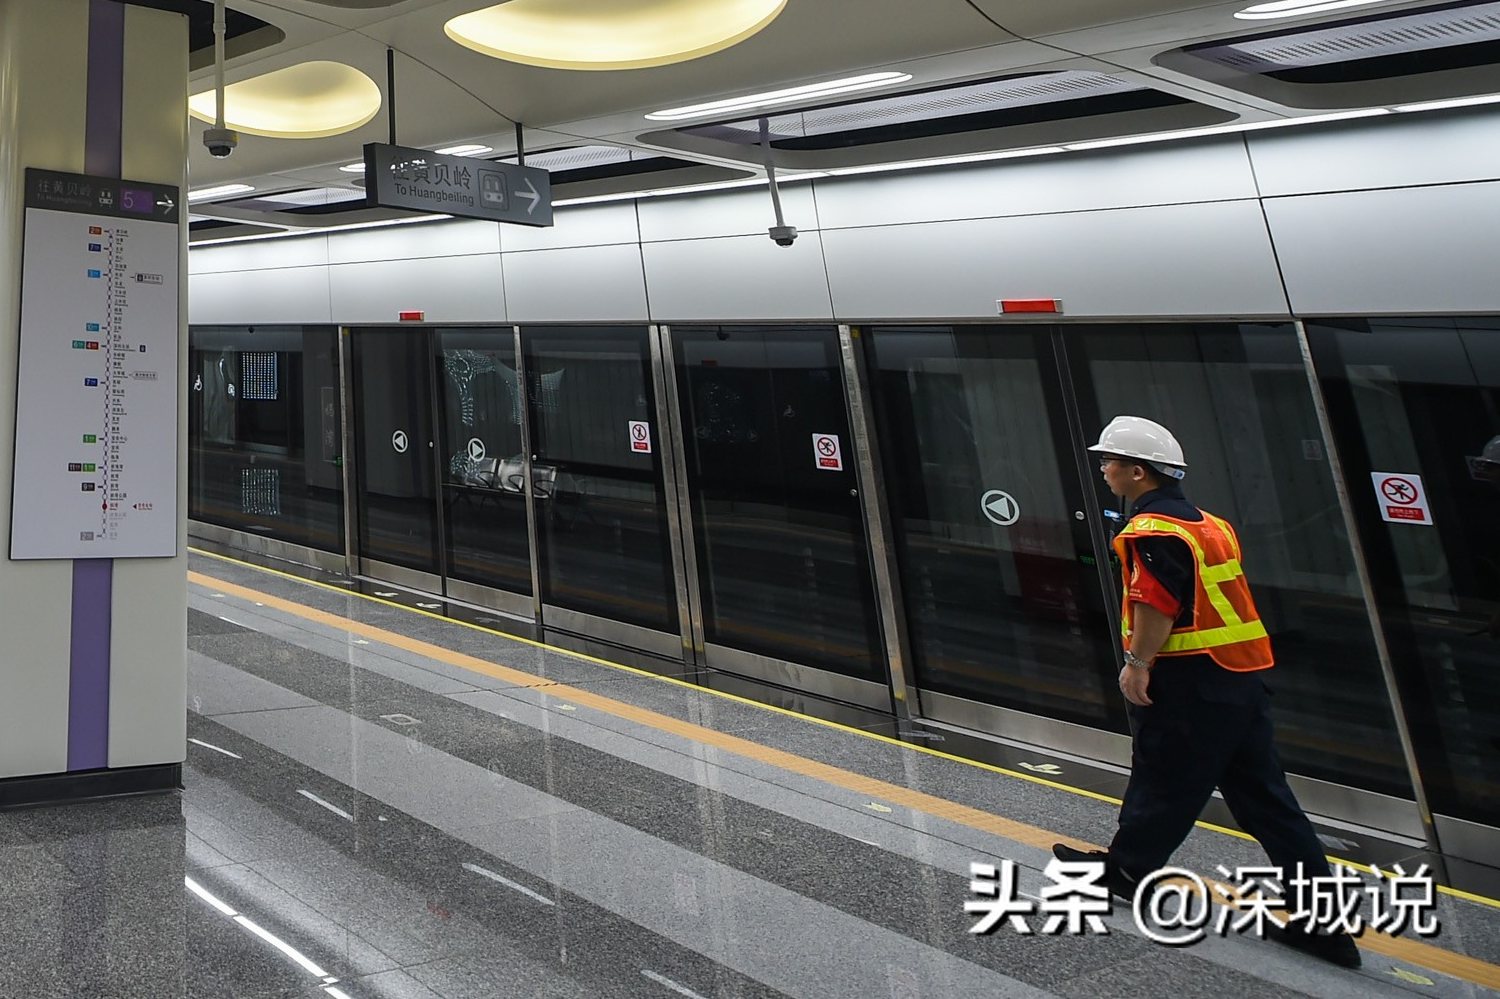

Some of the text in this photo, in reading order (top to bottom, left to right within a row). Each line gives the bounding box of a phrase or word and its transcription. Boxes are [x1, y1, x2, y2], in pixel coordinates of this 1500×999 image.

[389, 155, 472, 190] 往黄贝岭
[38, 179, 92, 197] 往黄贝岭
[394, 183, 474, 207] To Huangbeiling
[124, 191, 134, 208] 5
